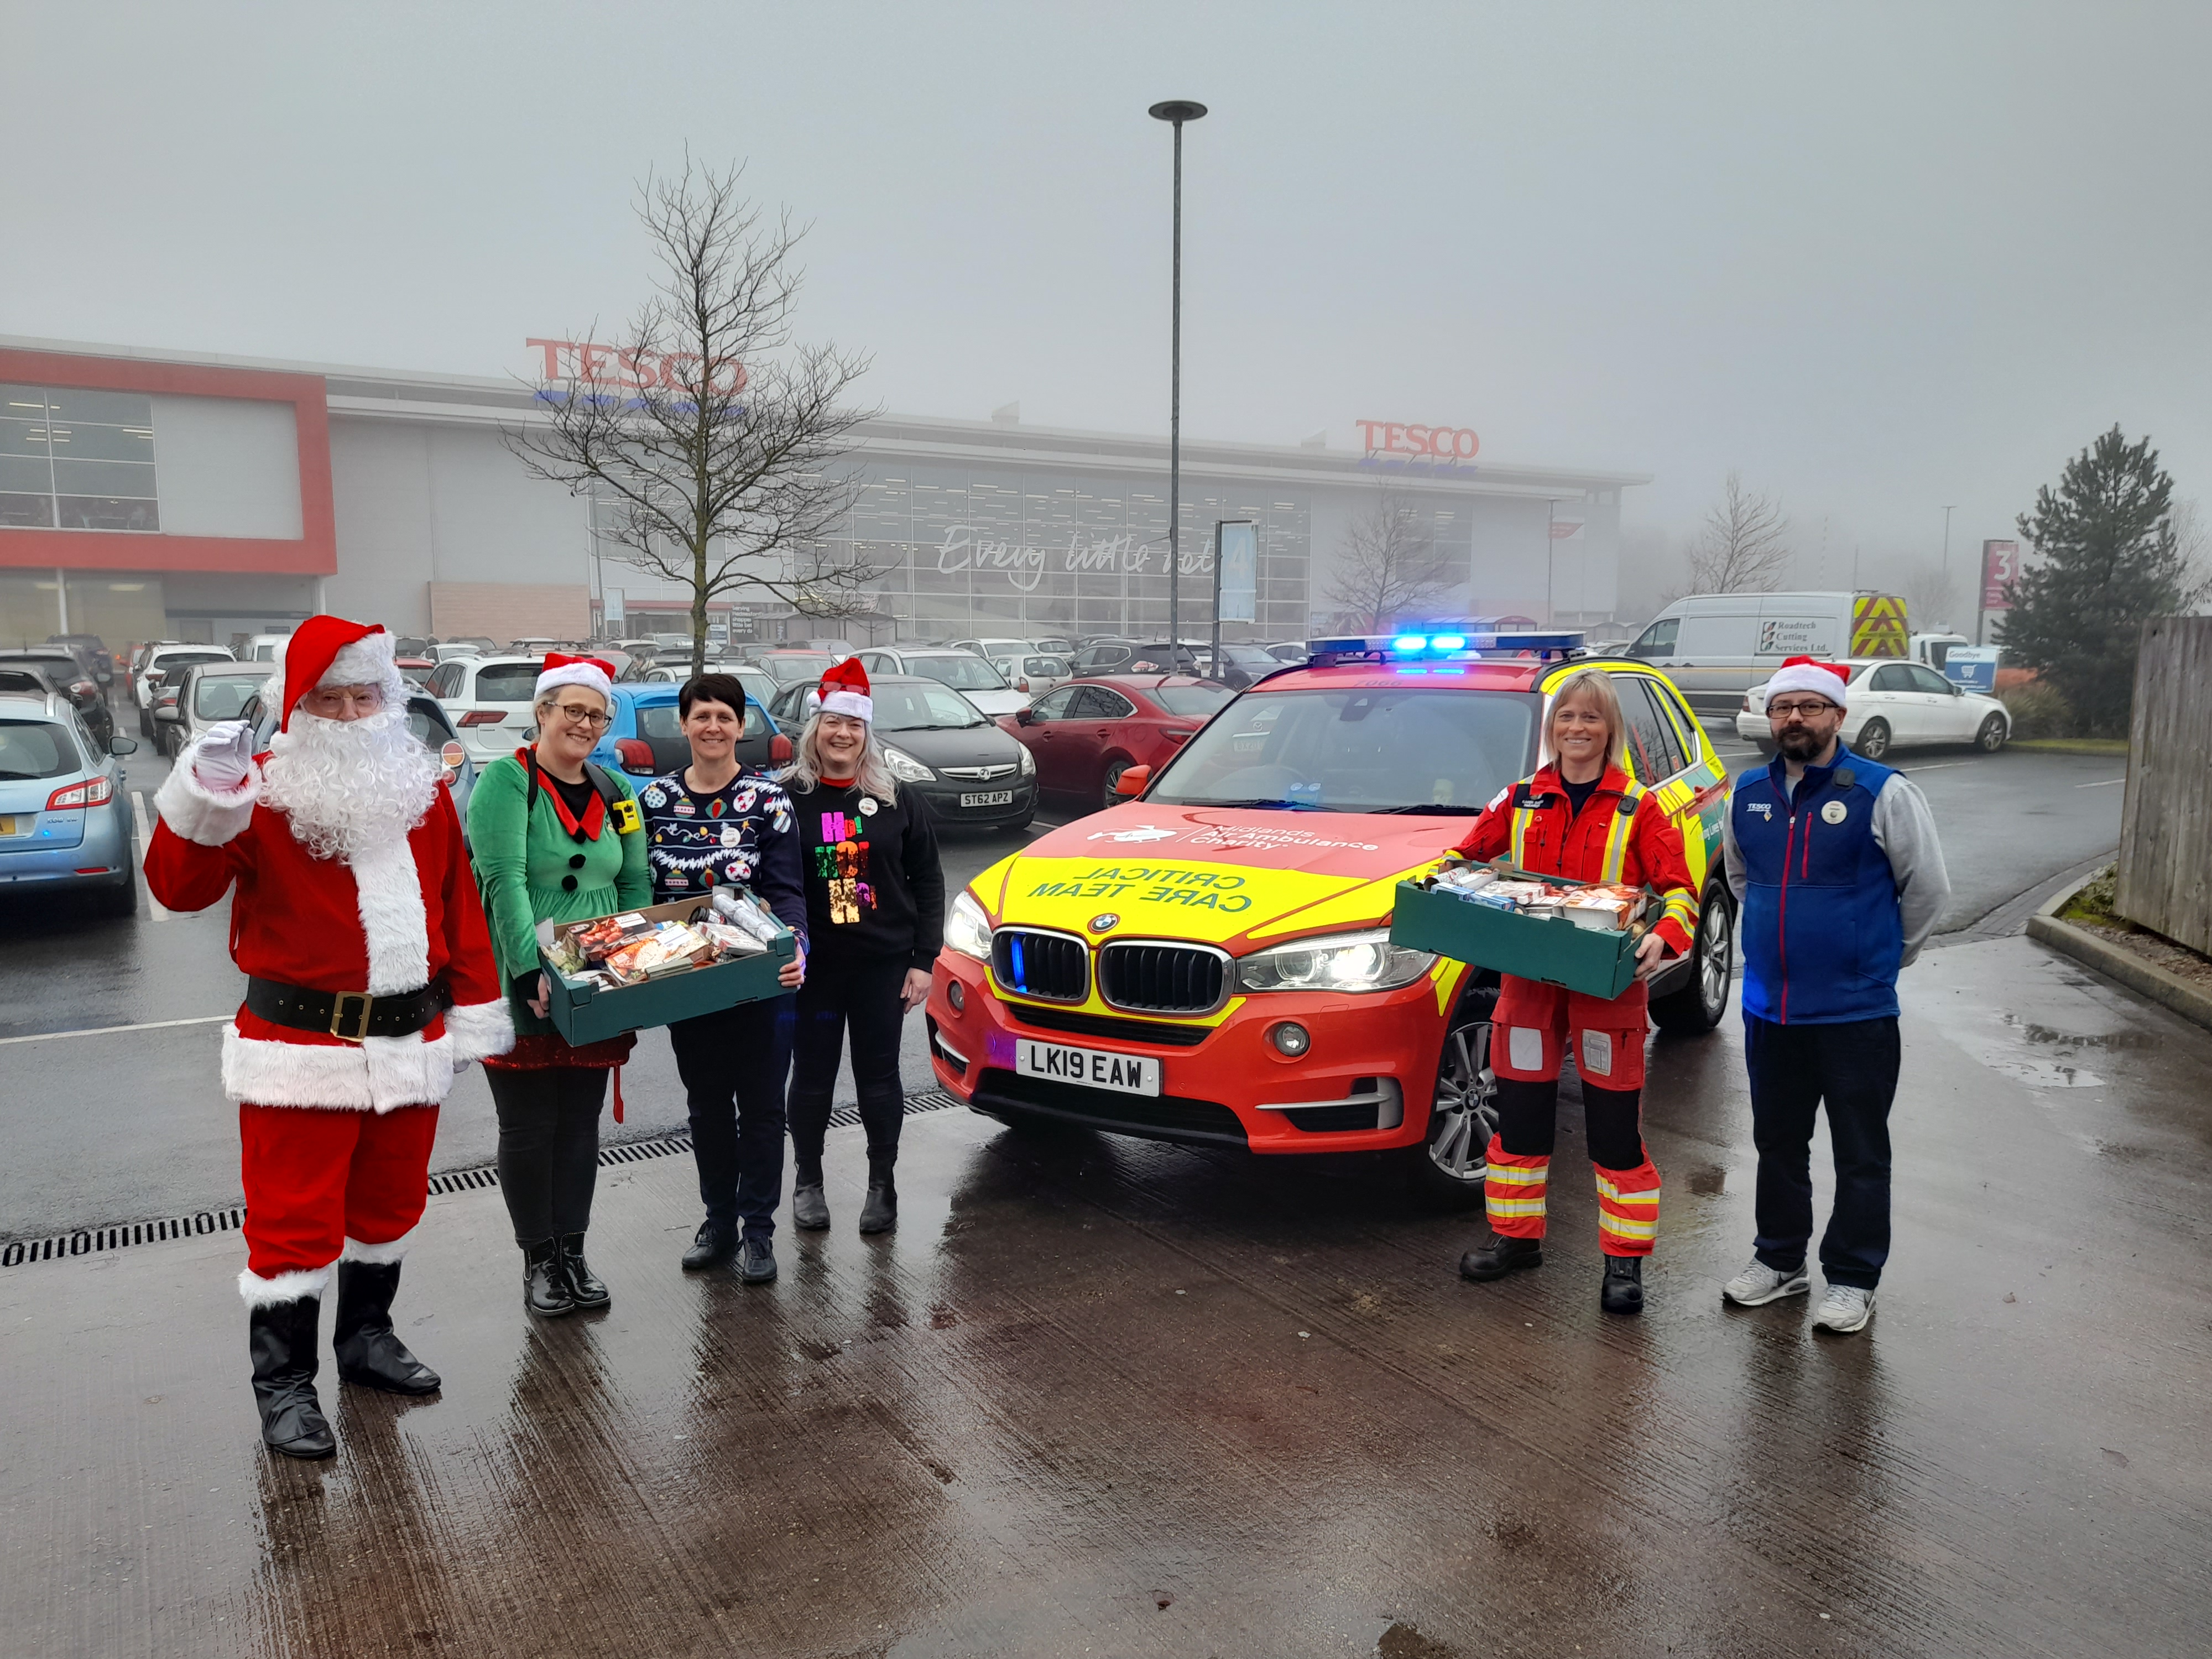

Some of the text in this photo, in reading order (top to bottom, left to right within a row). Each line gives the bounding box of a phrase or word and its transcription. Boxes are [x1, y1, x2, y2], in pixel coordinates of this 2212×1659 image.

[526, 337, 748, 397] TESCO
[1356, 419, 1480, 459] TESCO
[937, 525, 1046, 591] Every
[1065, 533, 1149, 572] little
[1227, 537, 1249, 579] 4
[1994, 550, 2012, 581] 3
[1776, 633, 1807, 641] Cutting
[1778, 621, 1816, 629] Roadtech
[1949, 651, 1981, 659] Goodbye
[964, 792, 1008, 805] ST62 APZ
[1212, 825, 1315, 837] Midlands
[1238, 832, 1379, 851] Ambulance
[1031, 1045, 1142, 1088] LK19 EAW
